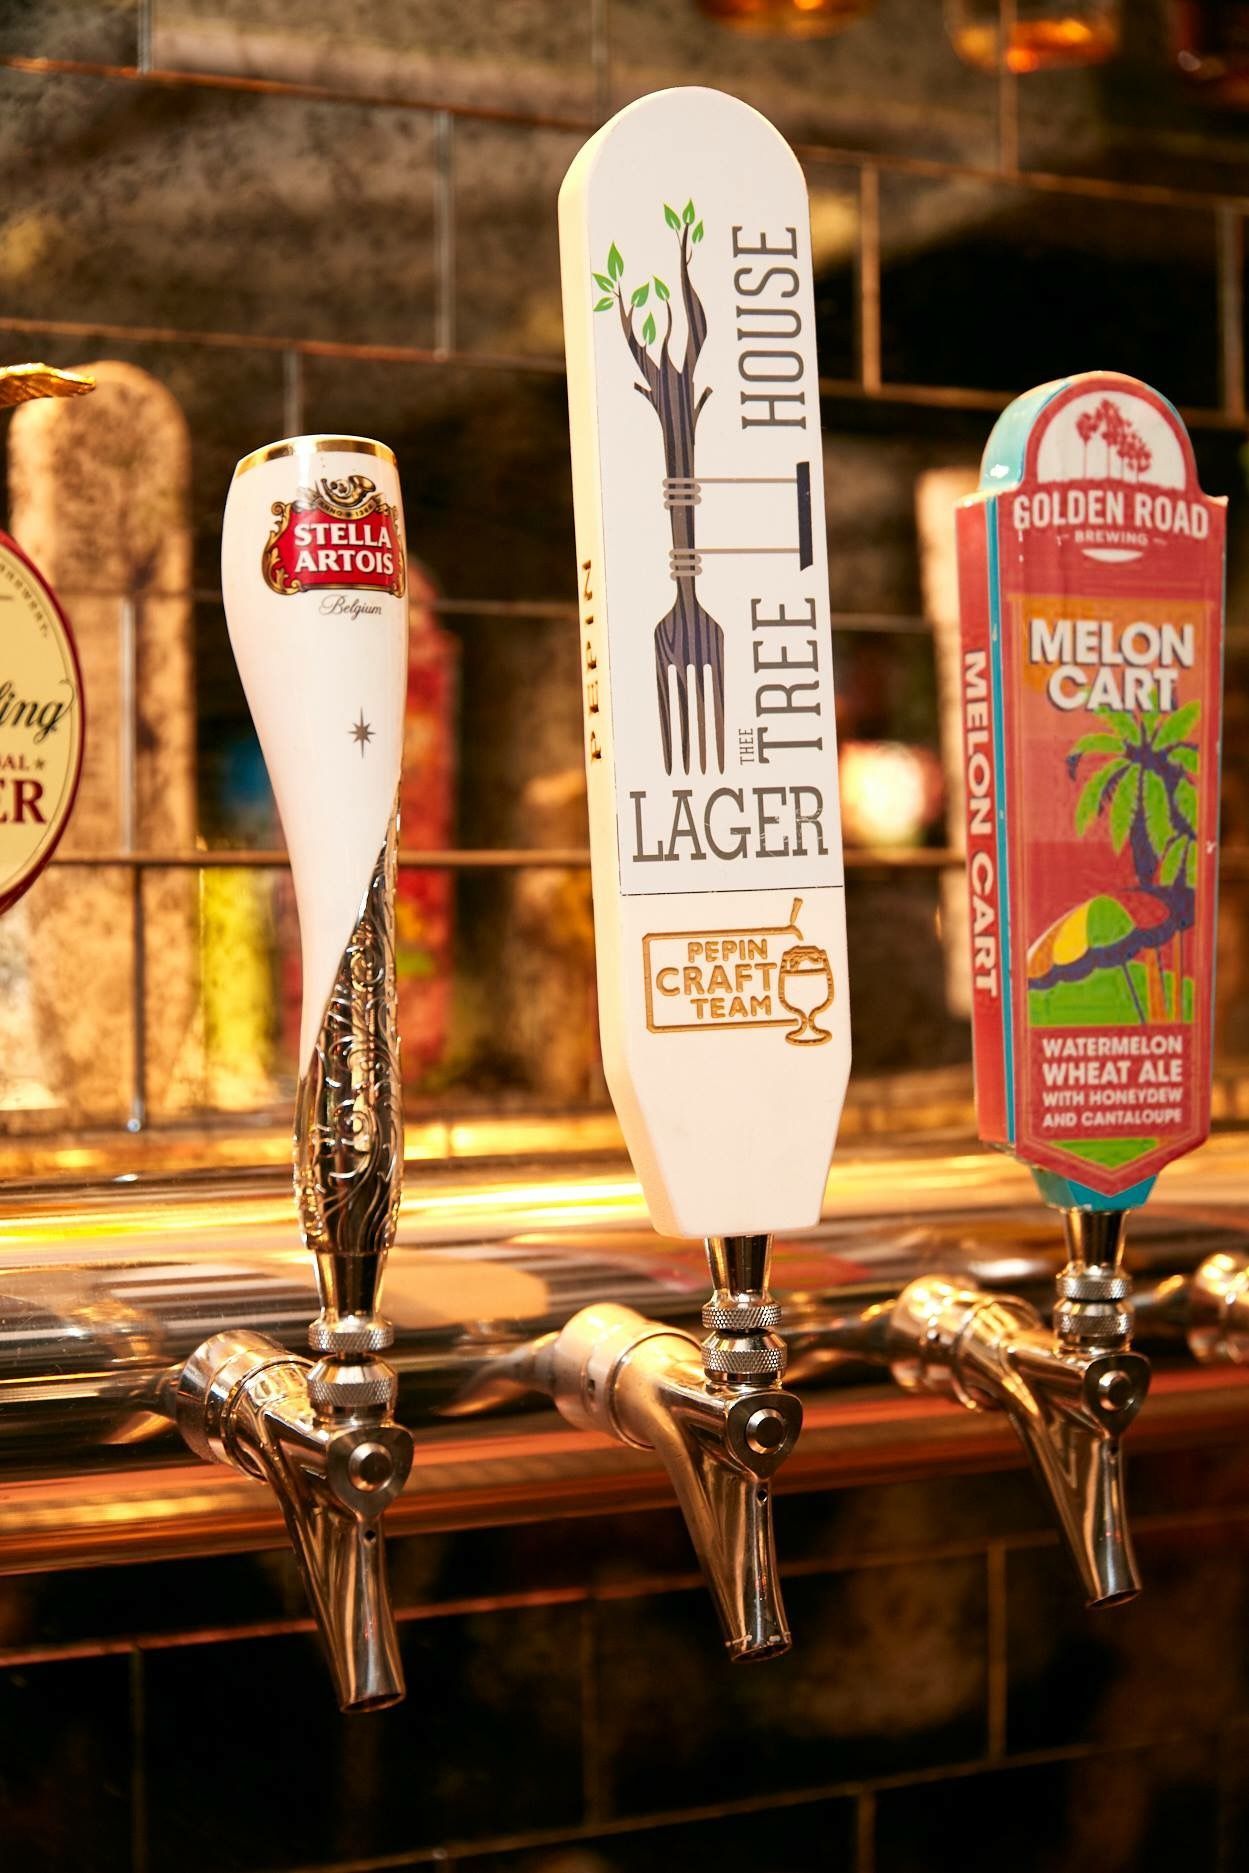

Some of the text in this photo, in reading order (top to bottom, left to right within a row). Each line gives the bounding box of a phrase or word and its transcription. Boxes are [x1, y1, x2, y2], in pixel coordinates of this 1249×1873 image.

[732, 226, 823, 764] TREE HOUSE
[1013, 490, 1209, 540] GOLDEN ROAD
[294, 523, 392, 549] STELLA
[1075, 530, 1149, 546] BREWING
[295, 550, 394, 575] ARTOIS
[319, 594, 383, 620] Belgium
[1030, 618, 1195, 669] MELON
[1048, 665, 1180, 712] CART
[738, 727, 755, 766] THEE
[0, 754, 30, 771] AL
[629, 786, 829, 862] LAGER
[964, 650, 999, 998] MELON CART
[687, 938, 769, 963] PEPIN
[656, 962, 777, 996] CRAFT
[690, 995, 772, 1019] TEAM
[1042, 1034, 1183, 1058] WATERMELON
[1042, 1059, 1183, 1086] WHEAT ALE
[1042, 1086, 1183, 1107] WITH HONEYDEW
[1042, 1108, 1182, 1128] AND CANTALOUPE
